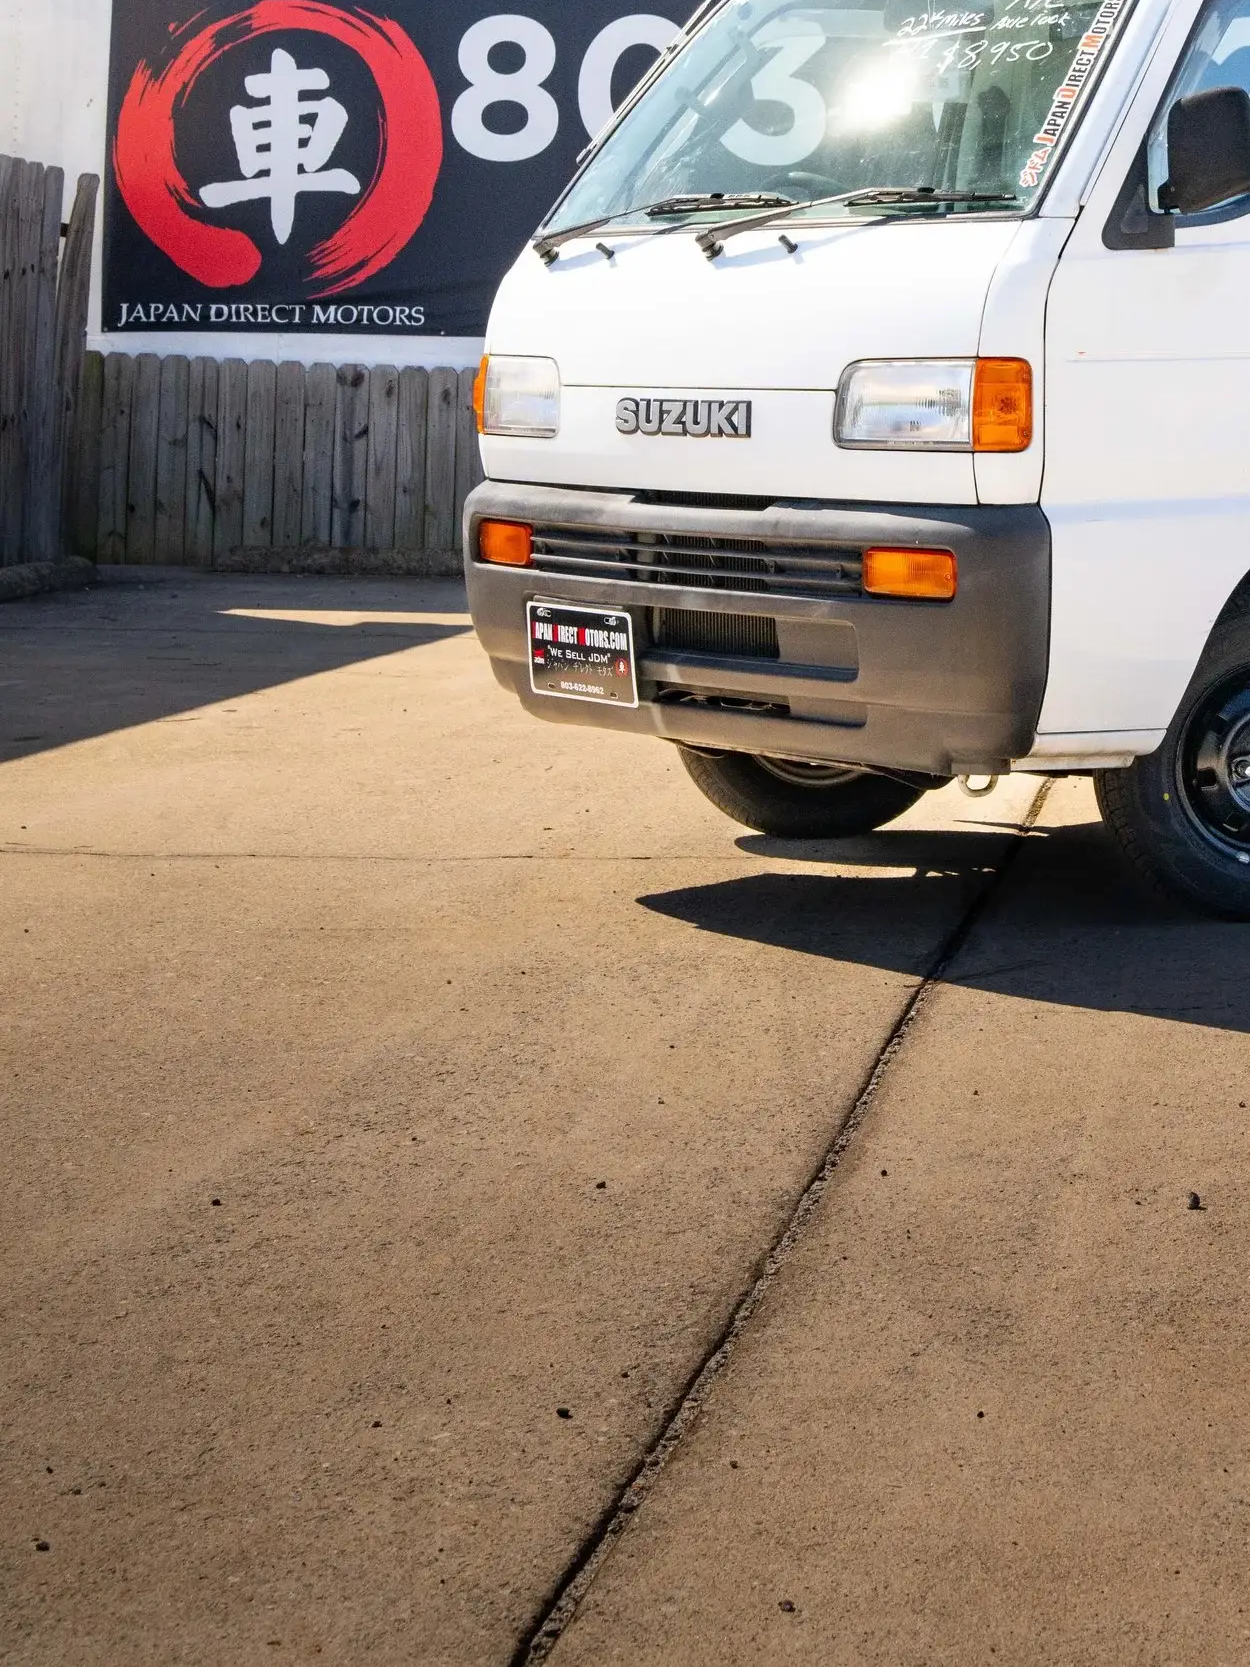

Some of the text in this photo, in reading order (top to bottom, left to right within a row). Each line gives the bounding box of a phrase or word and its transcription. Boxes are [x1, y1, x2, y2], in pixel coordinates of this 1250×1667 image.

[936, 39, 1055, 75] $8,950
[117, 303, 425, 327] JAPAN DIRECT MOTORS
[615, 398, 752, 438] SUZUKI
